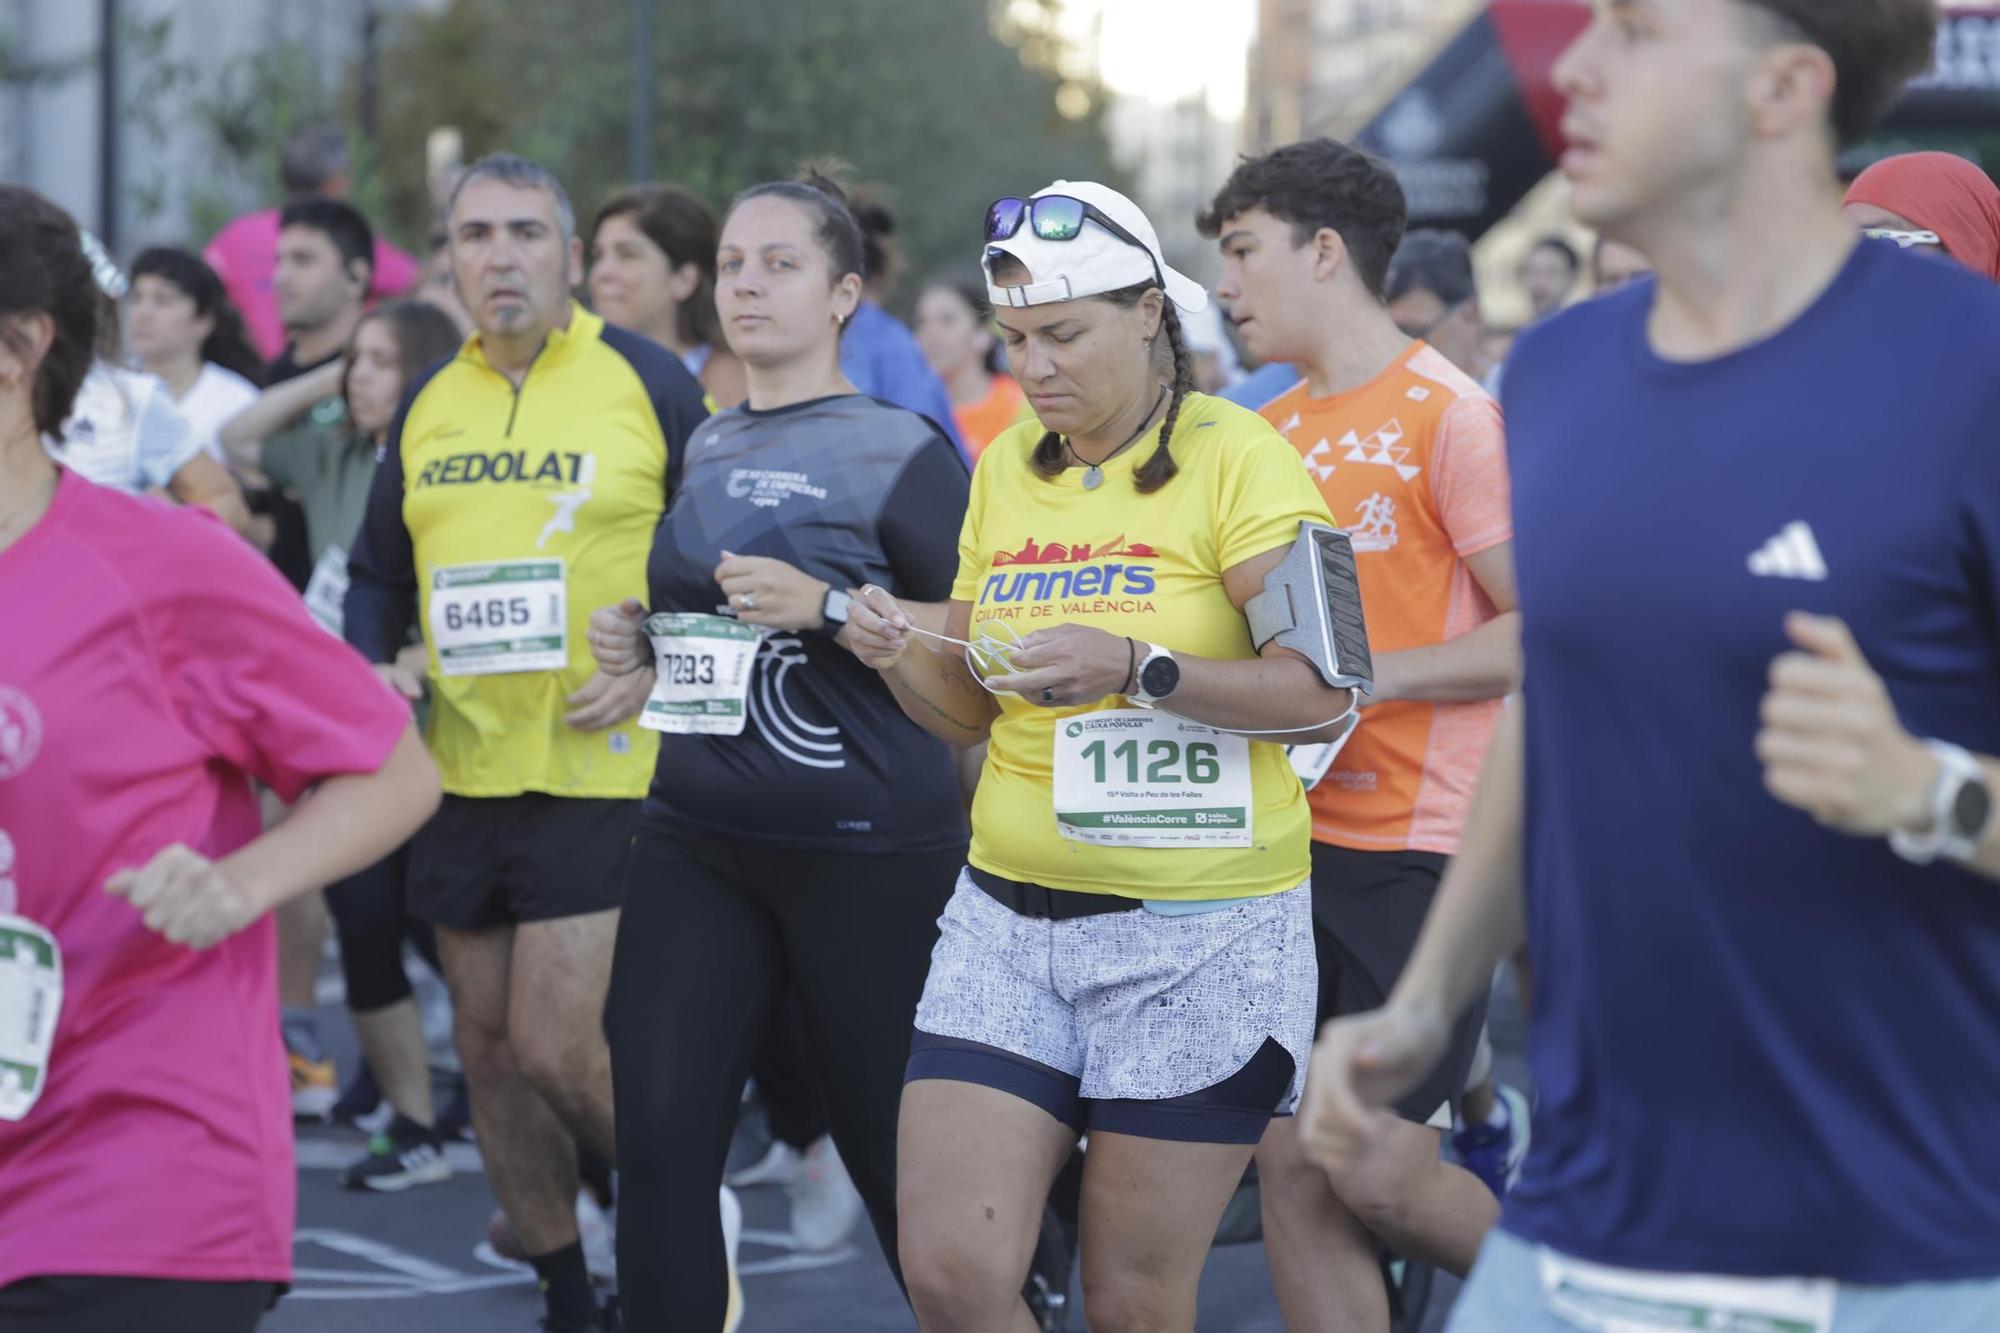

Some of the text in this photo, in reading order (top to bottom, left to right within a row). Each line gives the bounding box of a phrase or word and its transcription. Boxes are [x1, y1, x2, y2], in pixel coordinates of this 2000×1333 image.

[979, 563, 1156, 605] runners
[445, 597, 529, 630] 6465
[976, 598, 1156, 624] CIUTAT DE VALÈNCIA
[663, 653, 714, 685] 7293
[1085, 720, 1143, 729] CAIXA POPULAR
[1081, 739, 1220, 784] 1126
[1103, 814, 1188, 824] #ValènciaCorre
